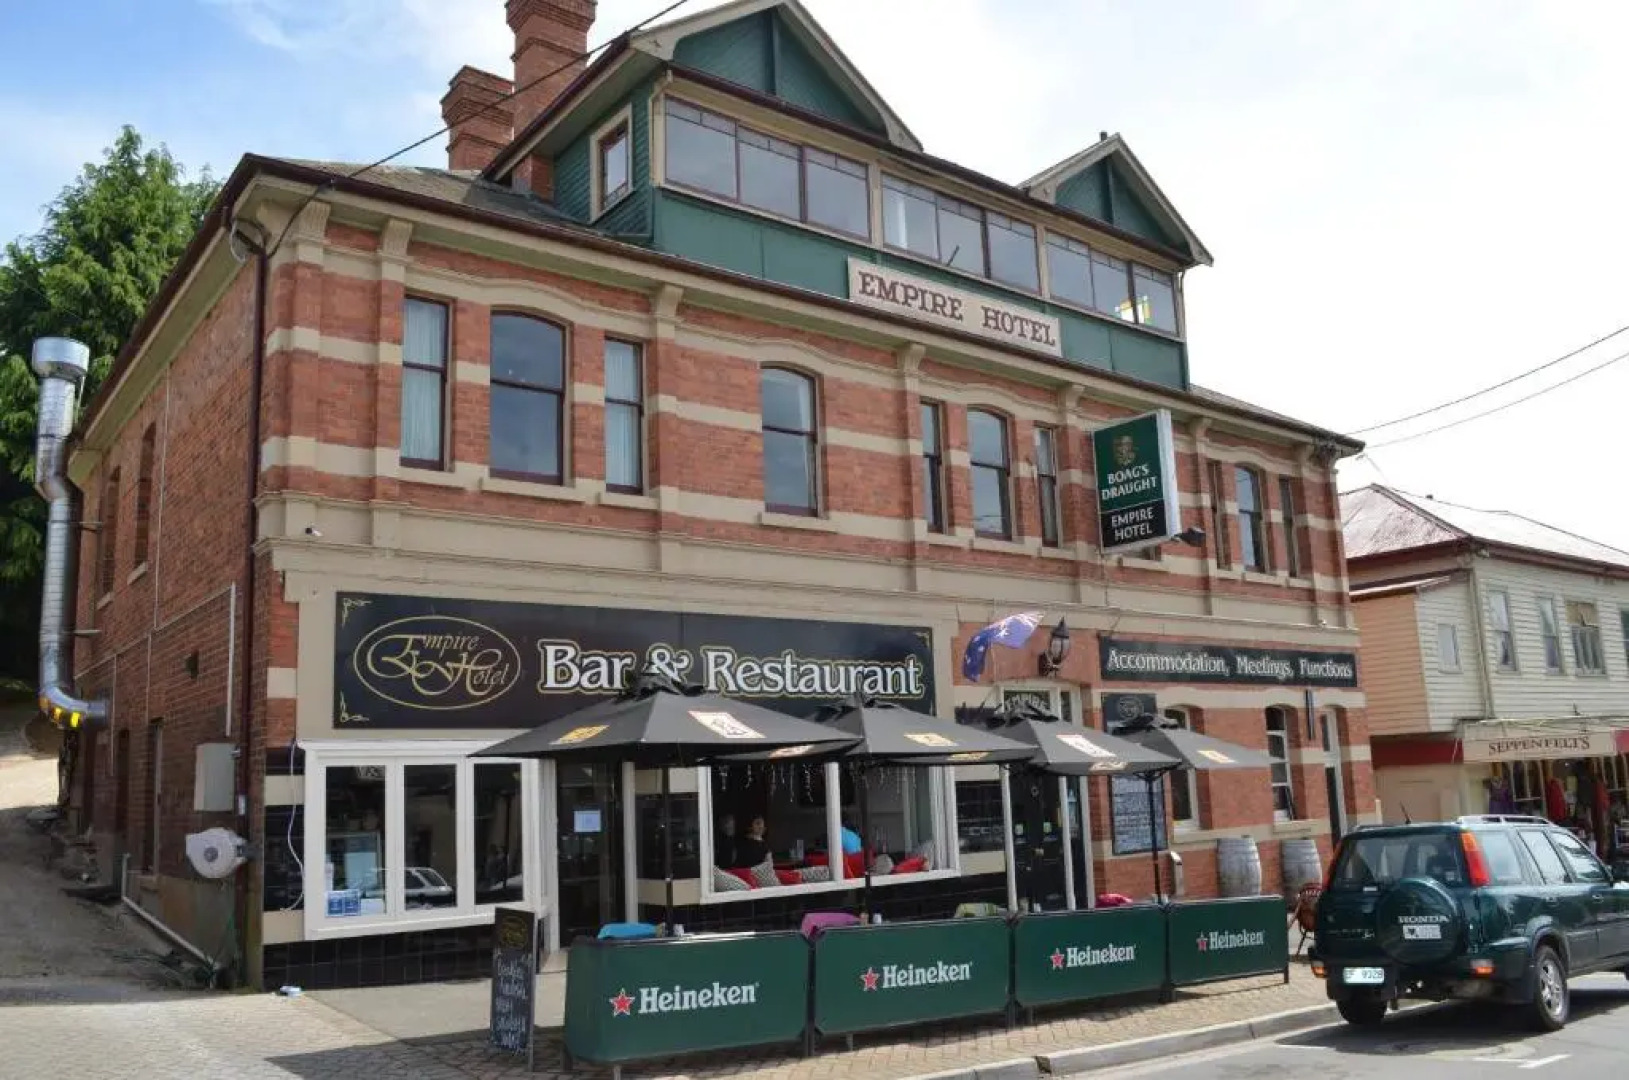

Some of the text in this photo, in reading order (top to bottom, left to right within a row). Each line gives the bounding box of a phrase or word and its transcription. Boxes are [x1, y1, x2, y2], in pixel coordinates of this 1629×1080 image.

[858, 271, 1056, 346] EMPIRE HOTEL
[1107, 464, 1150, 485] BOAG'S
[1101, 476, 1158, 500] DRAUGHT
[1111, 507, 1154, 528] EMPIRE
[1114, 522, 1153, 541] HOTEL
[366, 632, 480, 678] Empire
[1106, 648, 1230, 676] Accommodation,
[1299, 658, 1354, 678] Functions
[540, 642, 923, 697] Bar & Restaurant
[1398, 915, 1449, 924] HONDA
[1209, 928, 1264, 950] Heineken
[1066, 943, 1135, 968] Heineken
[882, 961, 971, 989] Heineken
[638, 982, 756, 1014] Heineken
